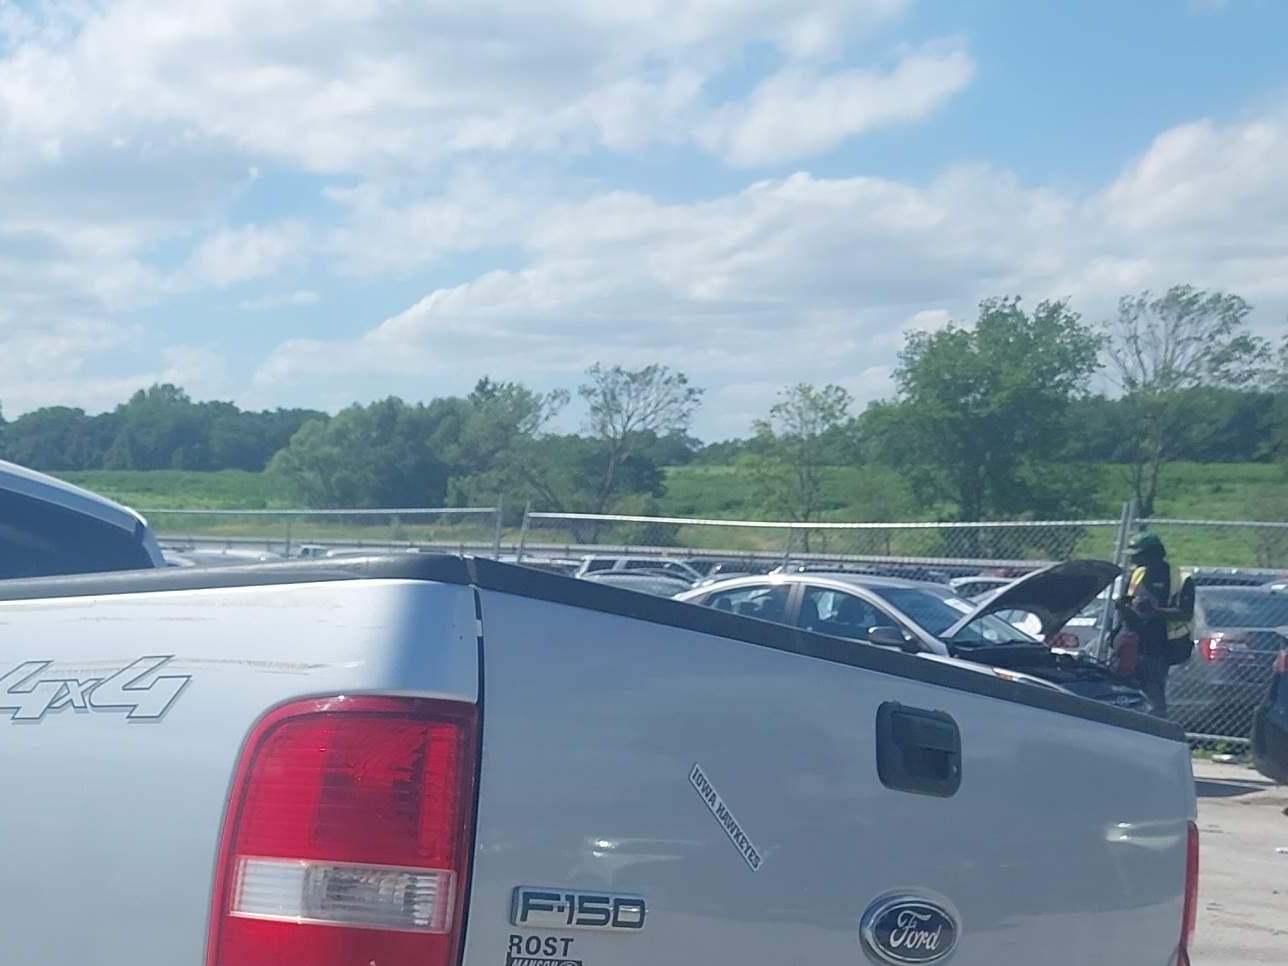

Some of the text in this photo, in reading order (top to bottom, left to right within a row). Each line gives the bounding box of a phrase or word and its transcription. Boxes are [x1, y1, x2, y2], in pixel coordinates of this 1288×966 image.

[692, 767, 761, 869] IOWA HAWKEYES
[519, 891, 646, 928] F-150
[509, 934, 574, 957] ROST
[889, 910, 942, 950] Ford
